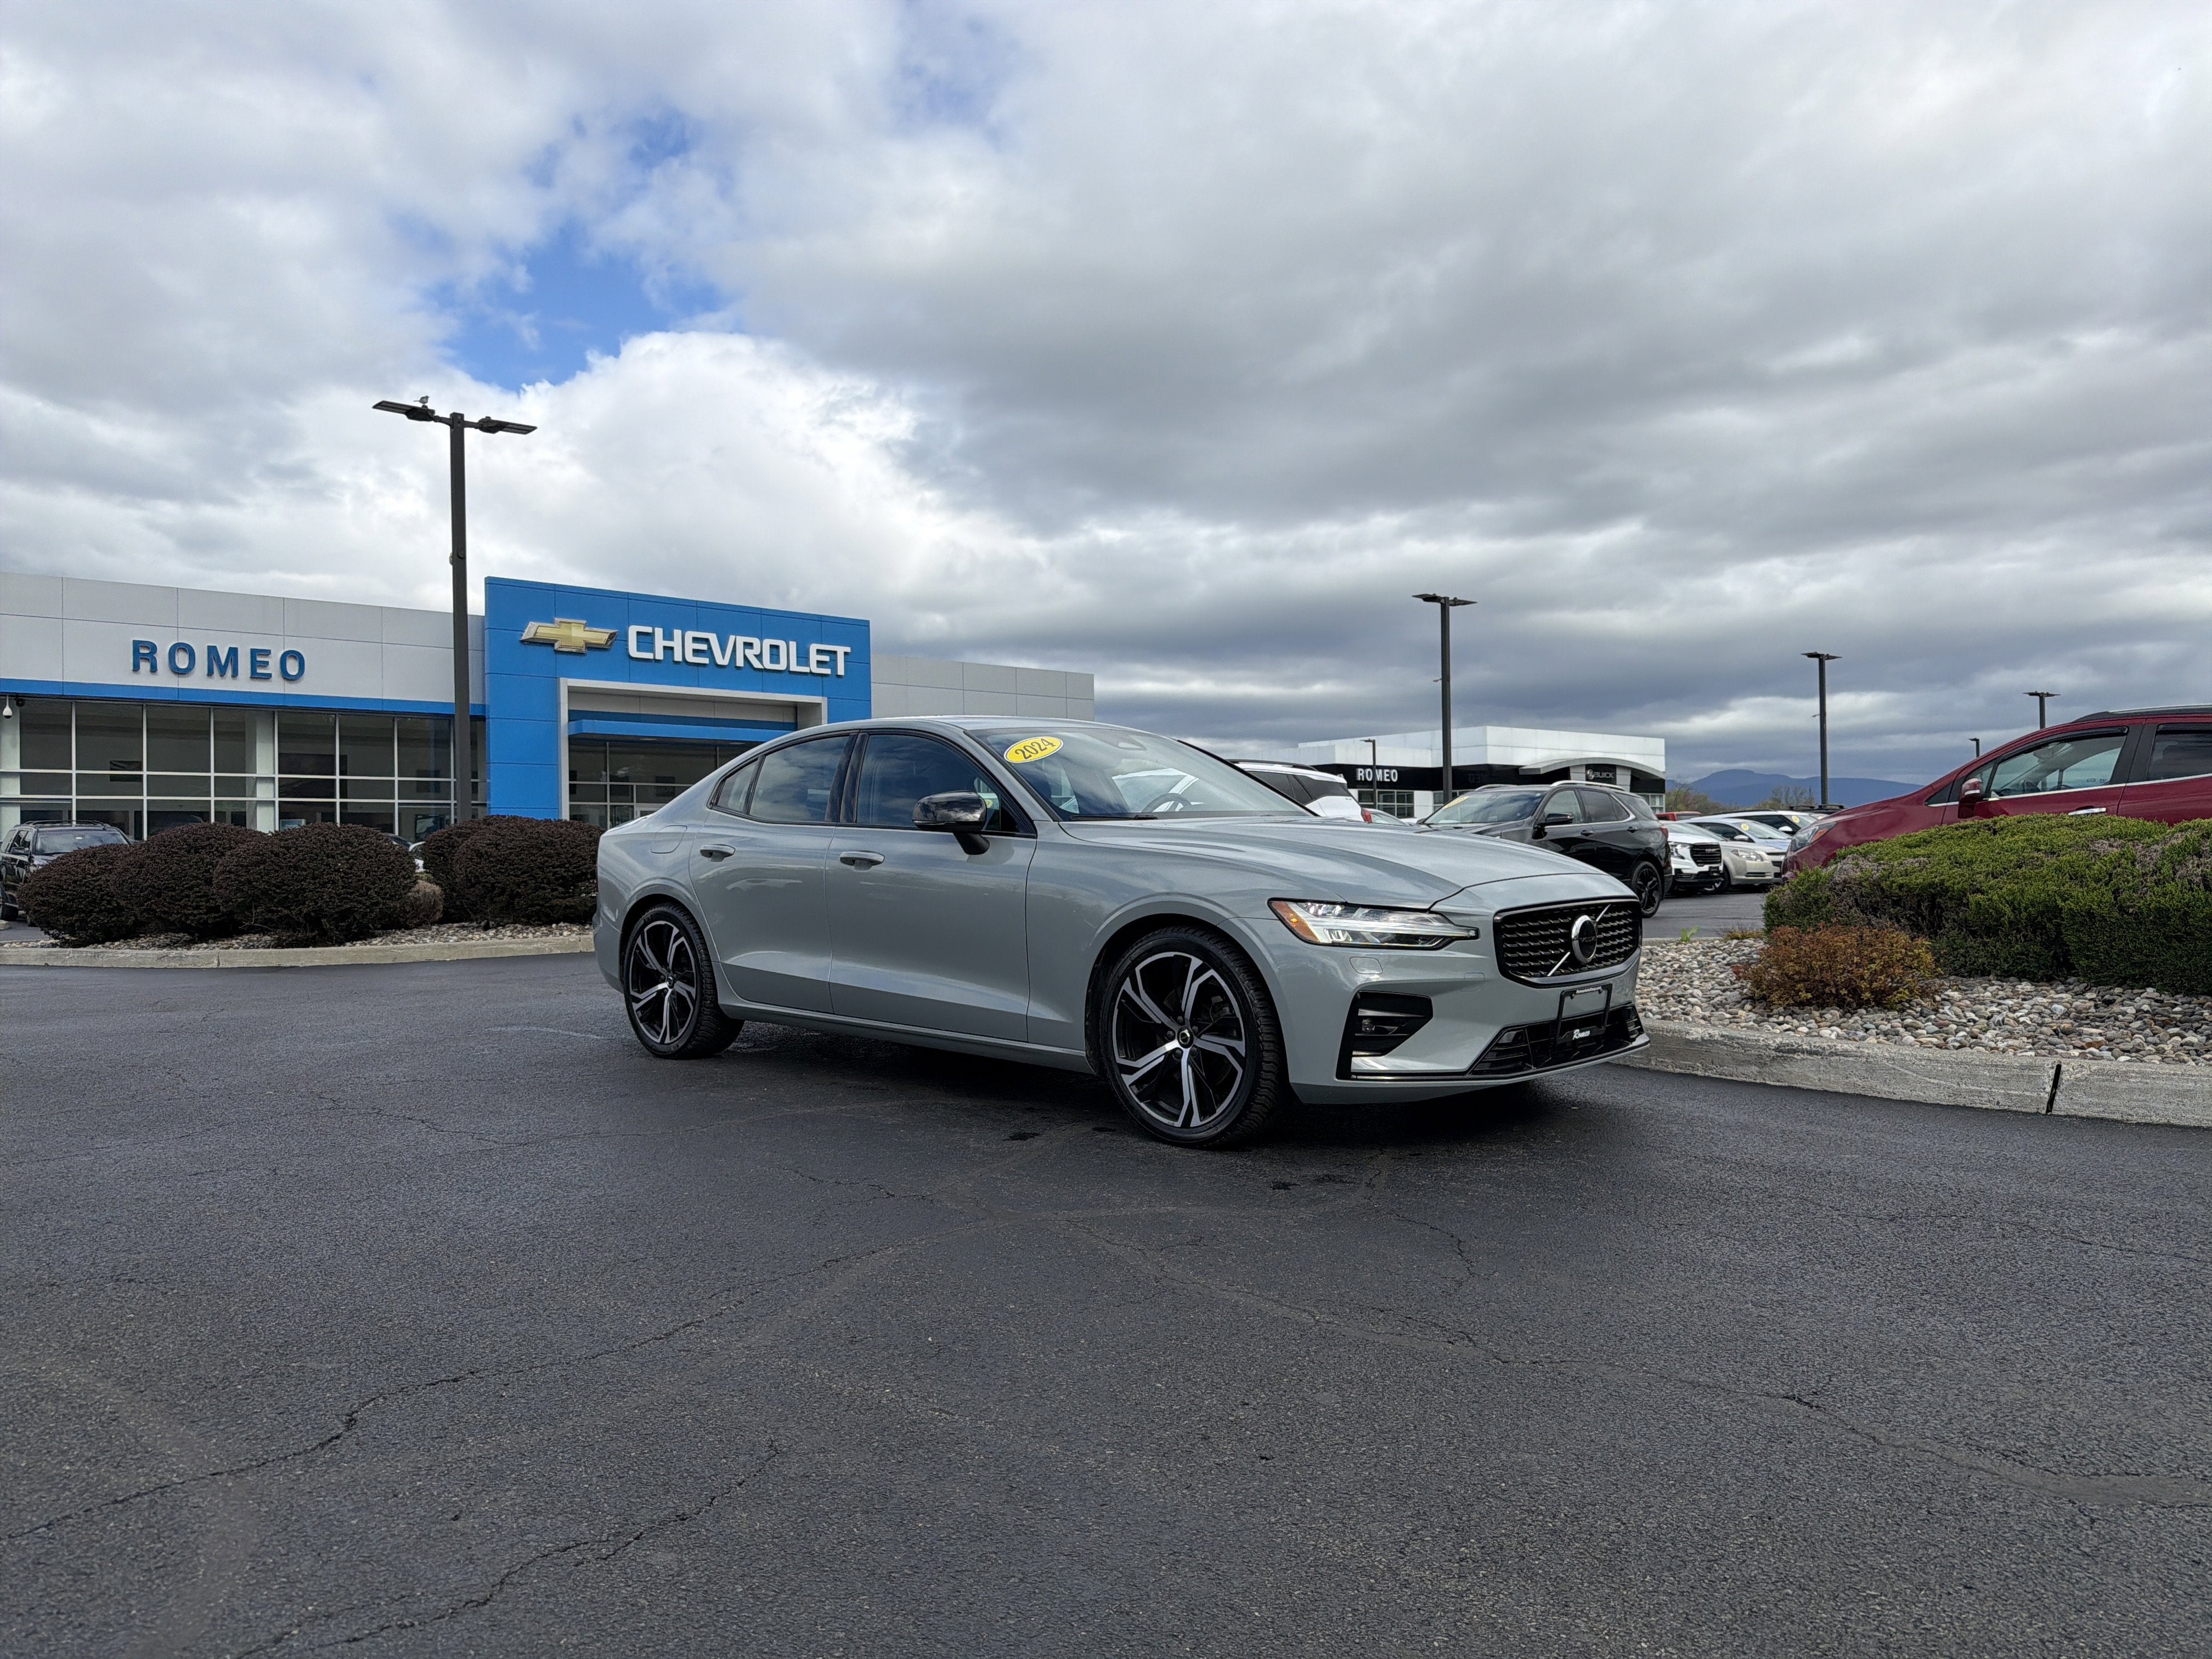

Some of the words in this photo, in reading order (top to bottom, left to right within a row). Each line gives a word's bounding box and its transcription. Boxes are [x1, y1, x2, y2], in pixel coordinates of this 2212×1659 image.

[132, 639, 305, 681] ROMEO
[628, 625, 851, 676] CHEVROLET
[1014, 738, 1056, 760] 2024
[1356, 768, 1398, 782] ROMEO
